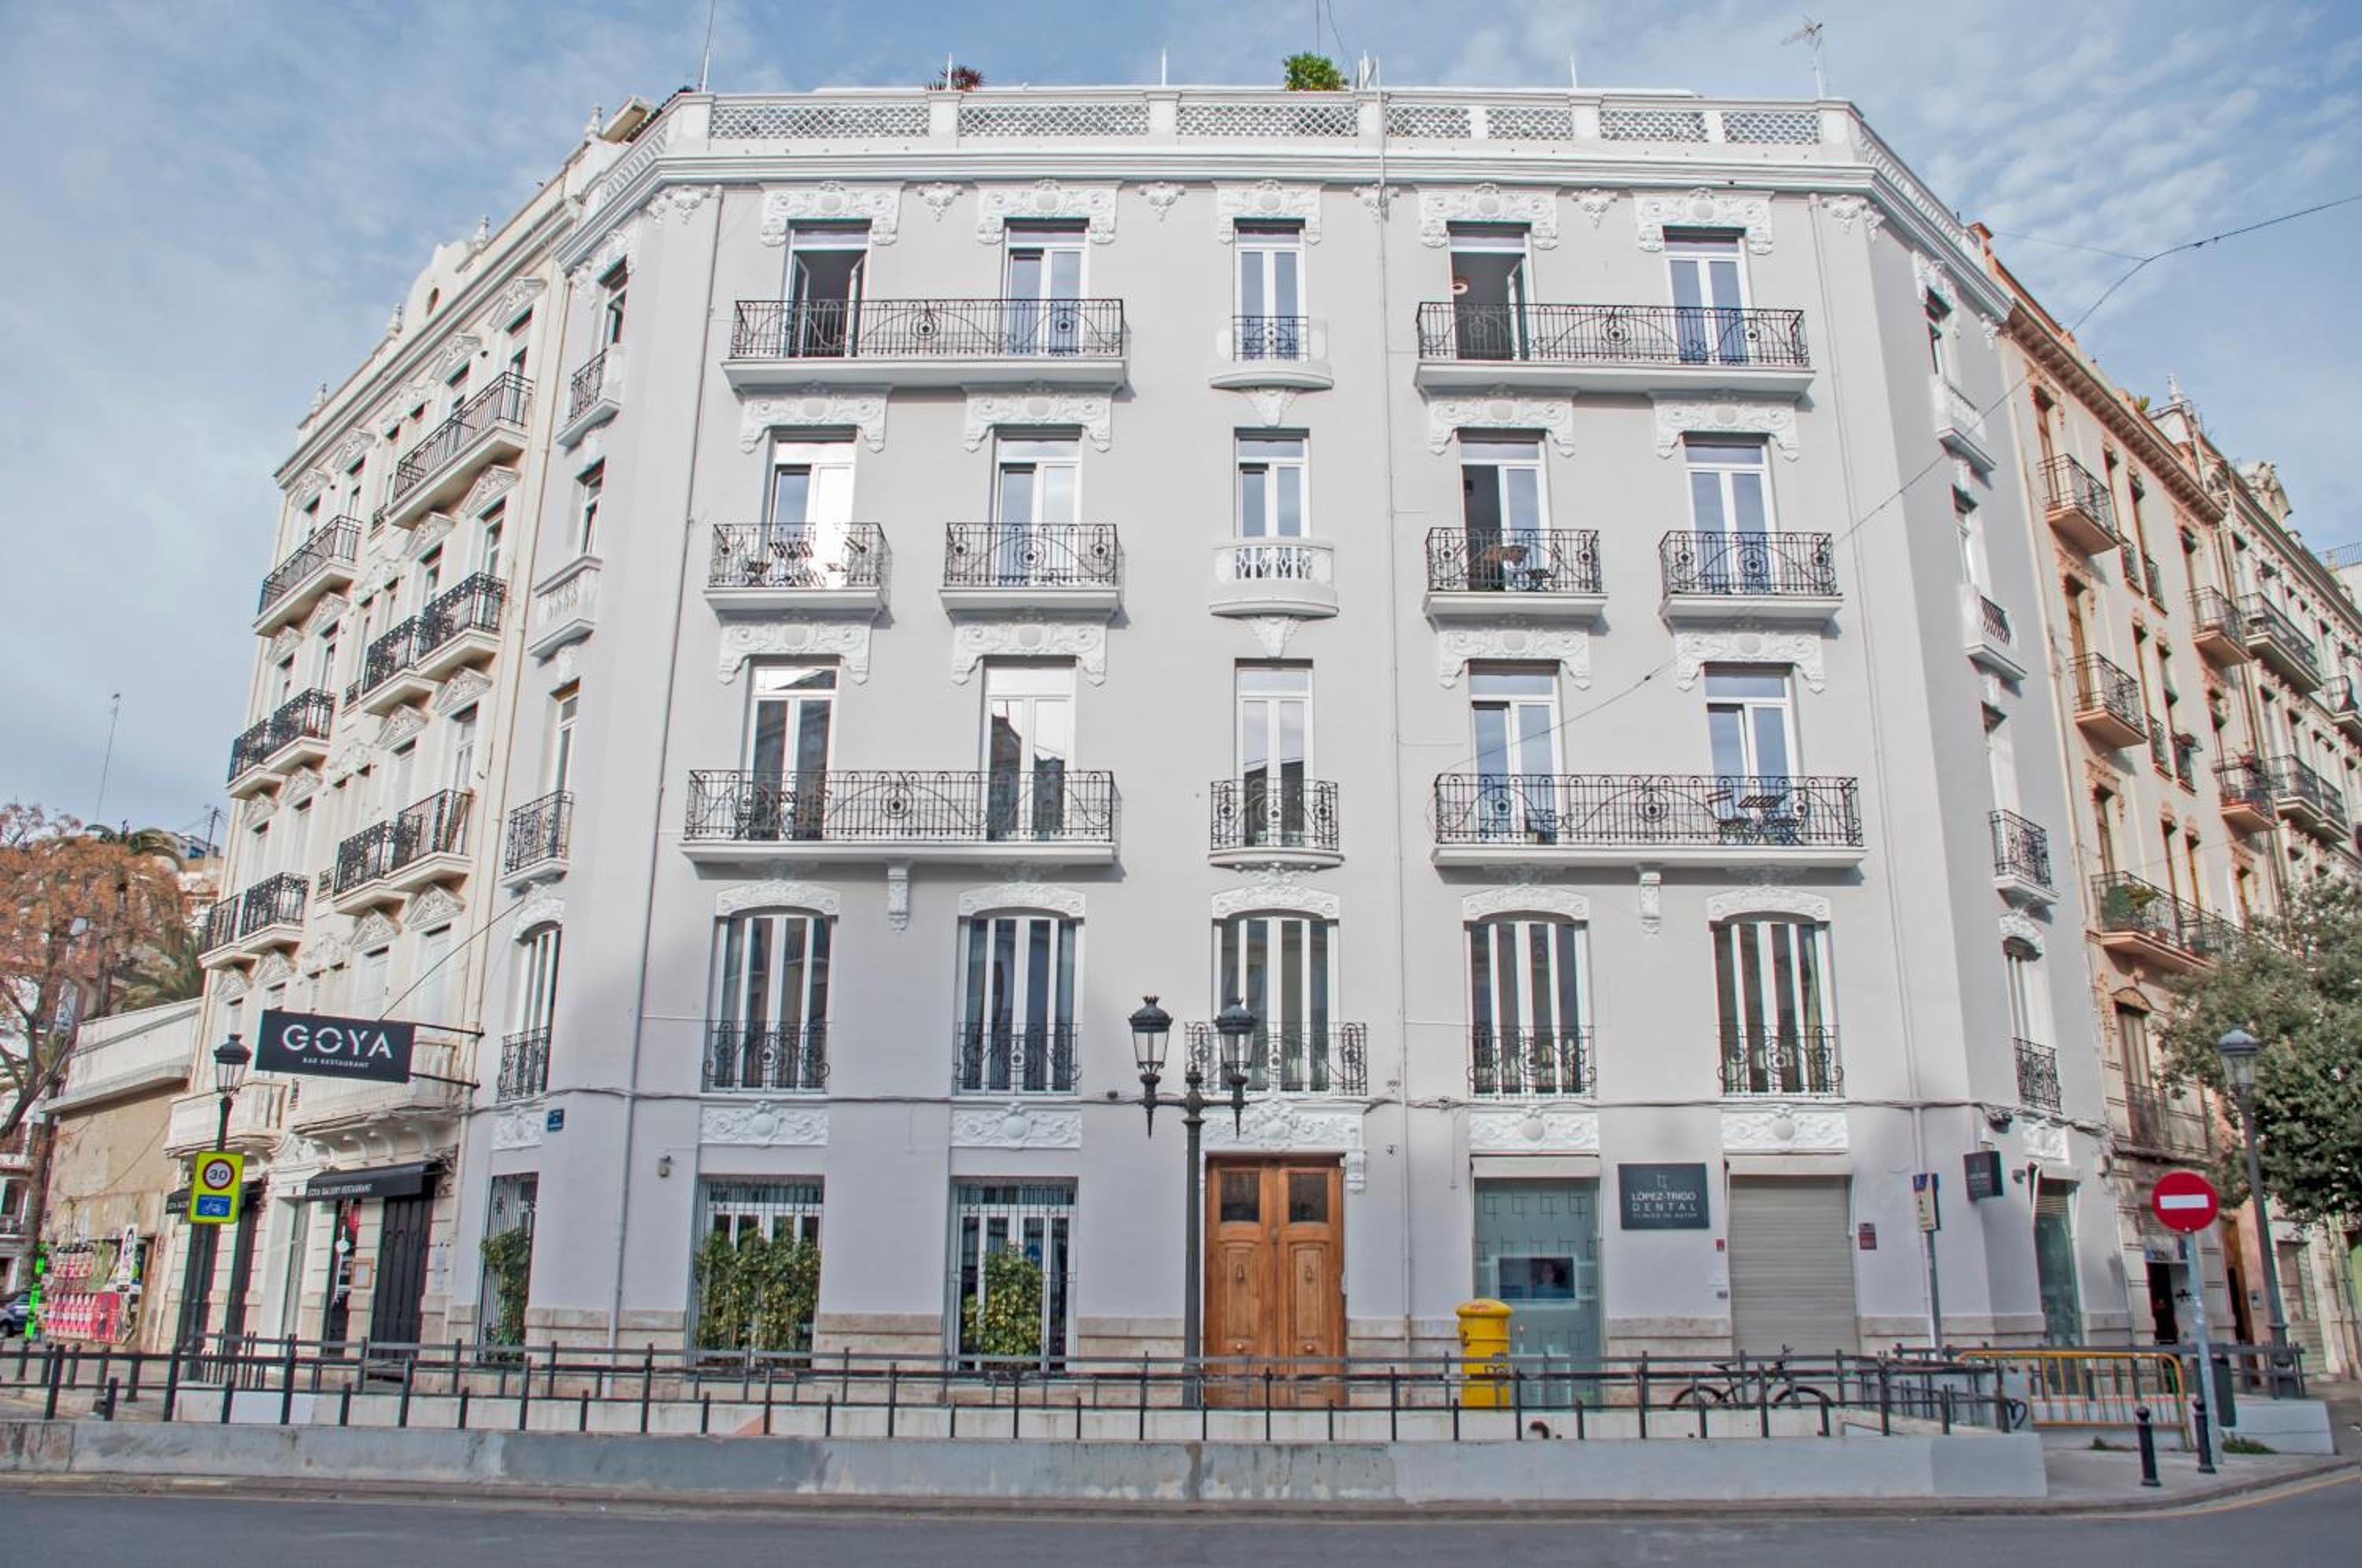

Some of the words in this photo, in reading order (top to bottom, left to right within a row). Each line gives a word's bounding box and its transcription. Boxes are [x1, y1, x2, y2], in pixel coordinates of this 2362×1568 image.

[282, 1024, 393, 1058] GOYA
[320, 1058, 370, 1068] RESTAURANT
[209, 1169, 228, 1180] 30
[1632, 1202, 1696, 1211] DENTAL
